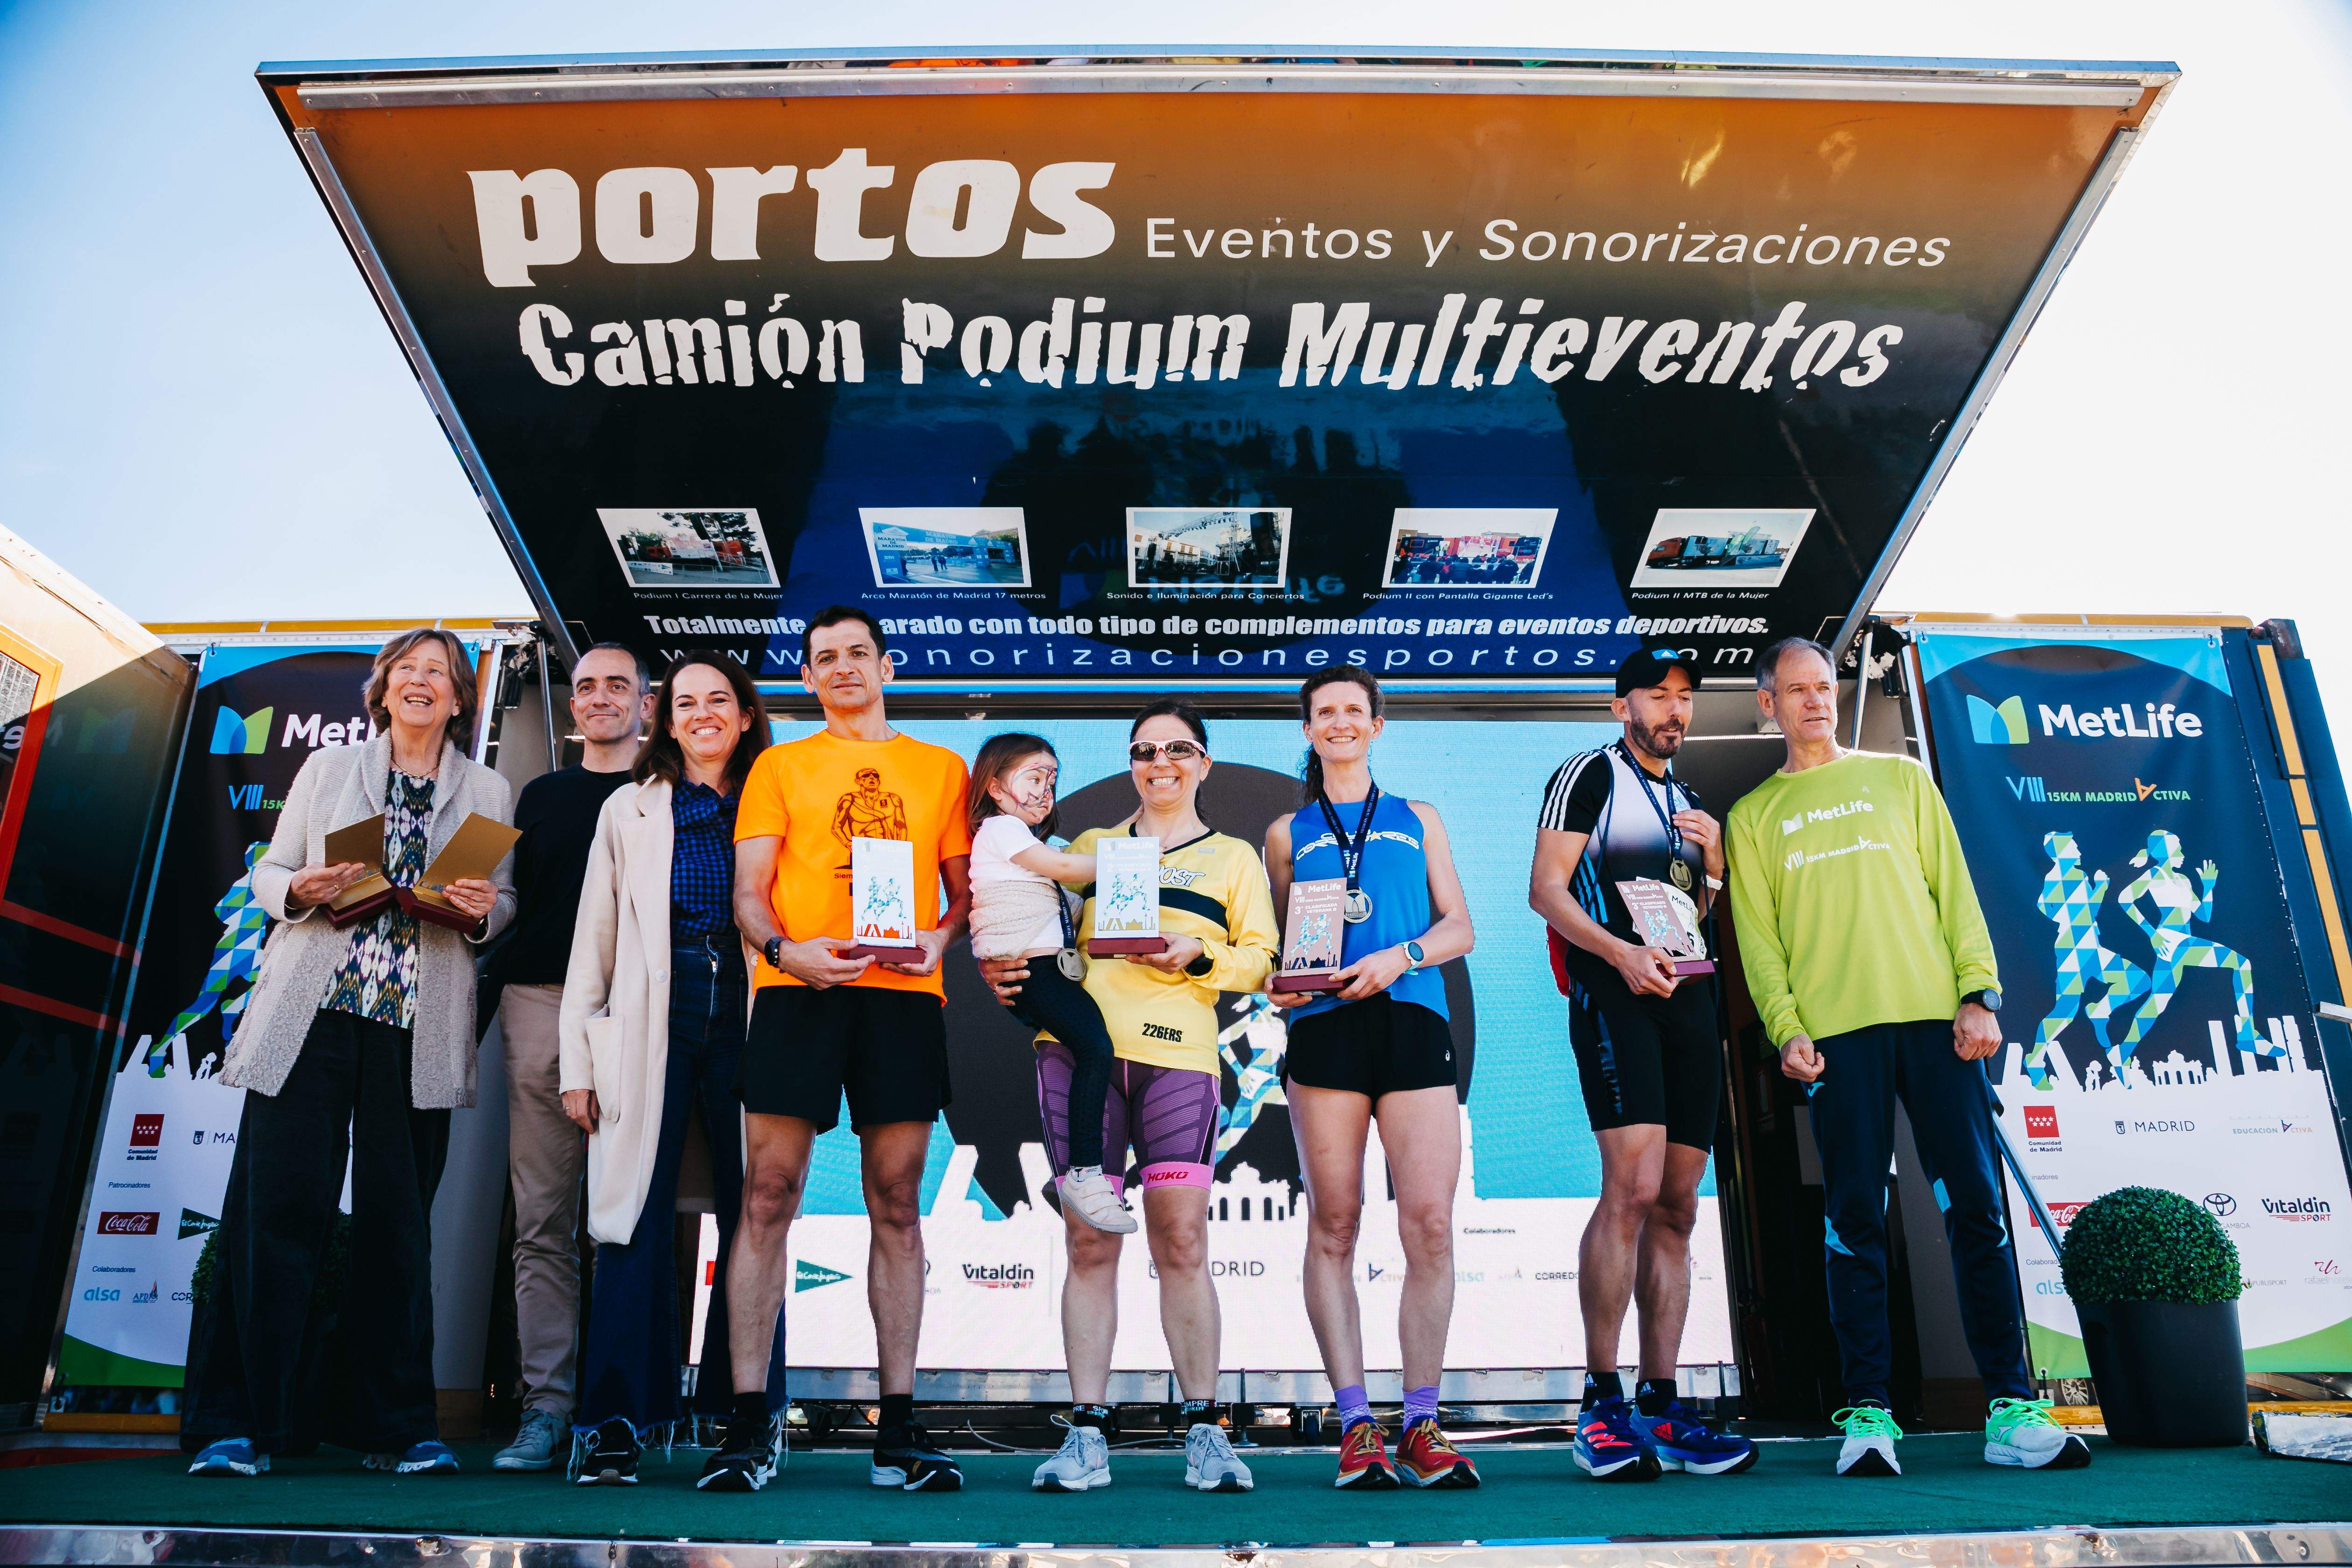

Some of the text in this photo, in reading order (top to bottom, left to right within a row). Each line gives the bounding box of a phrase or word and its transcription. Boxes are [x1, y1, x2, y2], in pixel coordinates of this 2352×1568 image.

[466, 147, 1116, 287] portos
[1146, 217, 1950, 267] Eventos y Sonorizaciones
[518, 293, 1903, 393] Camión Podium Multieventos
[643, 615, 1769, 637] Totalmente arado con todo tipo de complementos para eventos deportivos.
[281, 714, 378, 748] MetL
[2038, 702, 2203, 739] MetLife
[228, 784, 285, 810] VIII 15K
[2005, 776, 2046, 802] VIII
[2047, 792, 2081, 802] 15KM
[2086, 791, 2137, 802] MADRID
[1806, 799, 1874, 823] MetLife
[1118, 841, 1155, 850] MetLife
[1784, 850, 1805, 872] VIII
[1806, 851, 1826, 863] 15KM
[1828, 845, 1859, 858] MADRID
[1308, 882, 1342, 893] MetLife
[1632, 883, 1660, 892] MetLife
[1141, 1023, 1183, 1043] 226ERS
[2135, 1120, 2195, 1133] MADRID
[2261, 1197, 2331, 1213] Vitaldin
[962, 1263, 1034, 1280] Vitaldin
[1211, 1261, 1265, 1277] DRID
[84, 1287, 120, 1301] alsa
[2036, 1279, 2063, 1295] als
